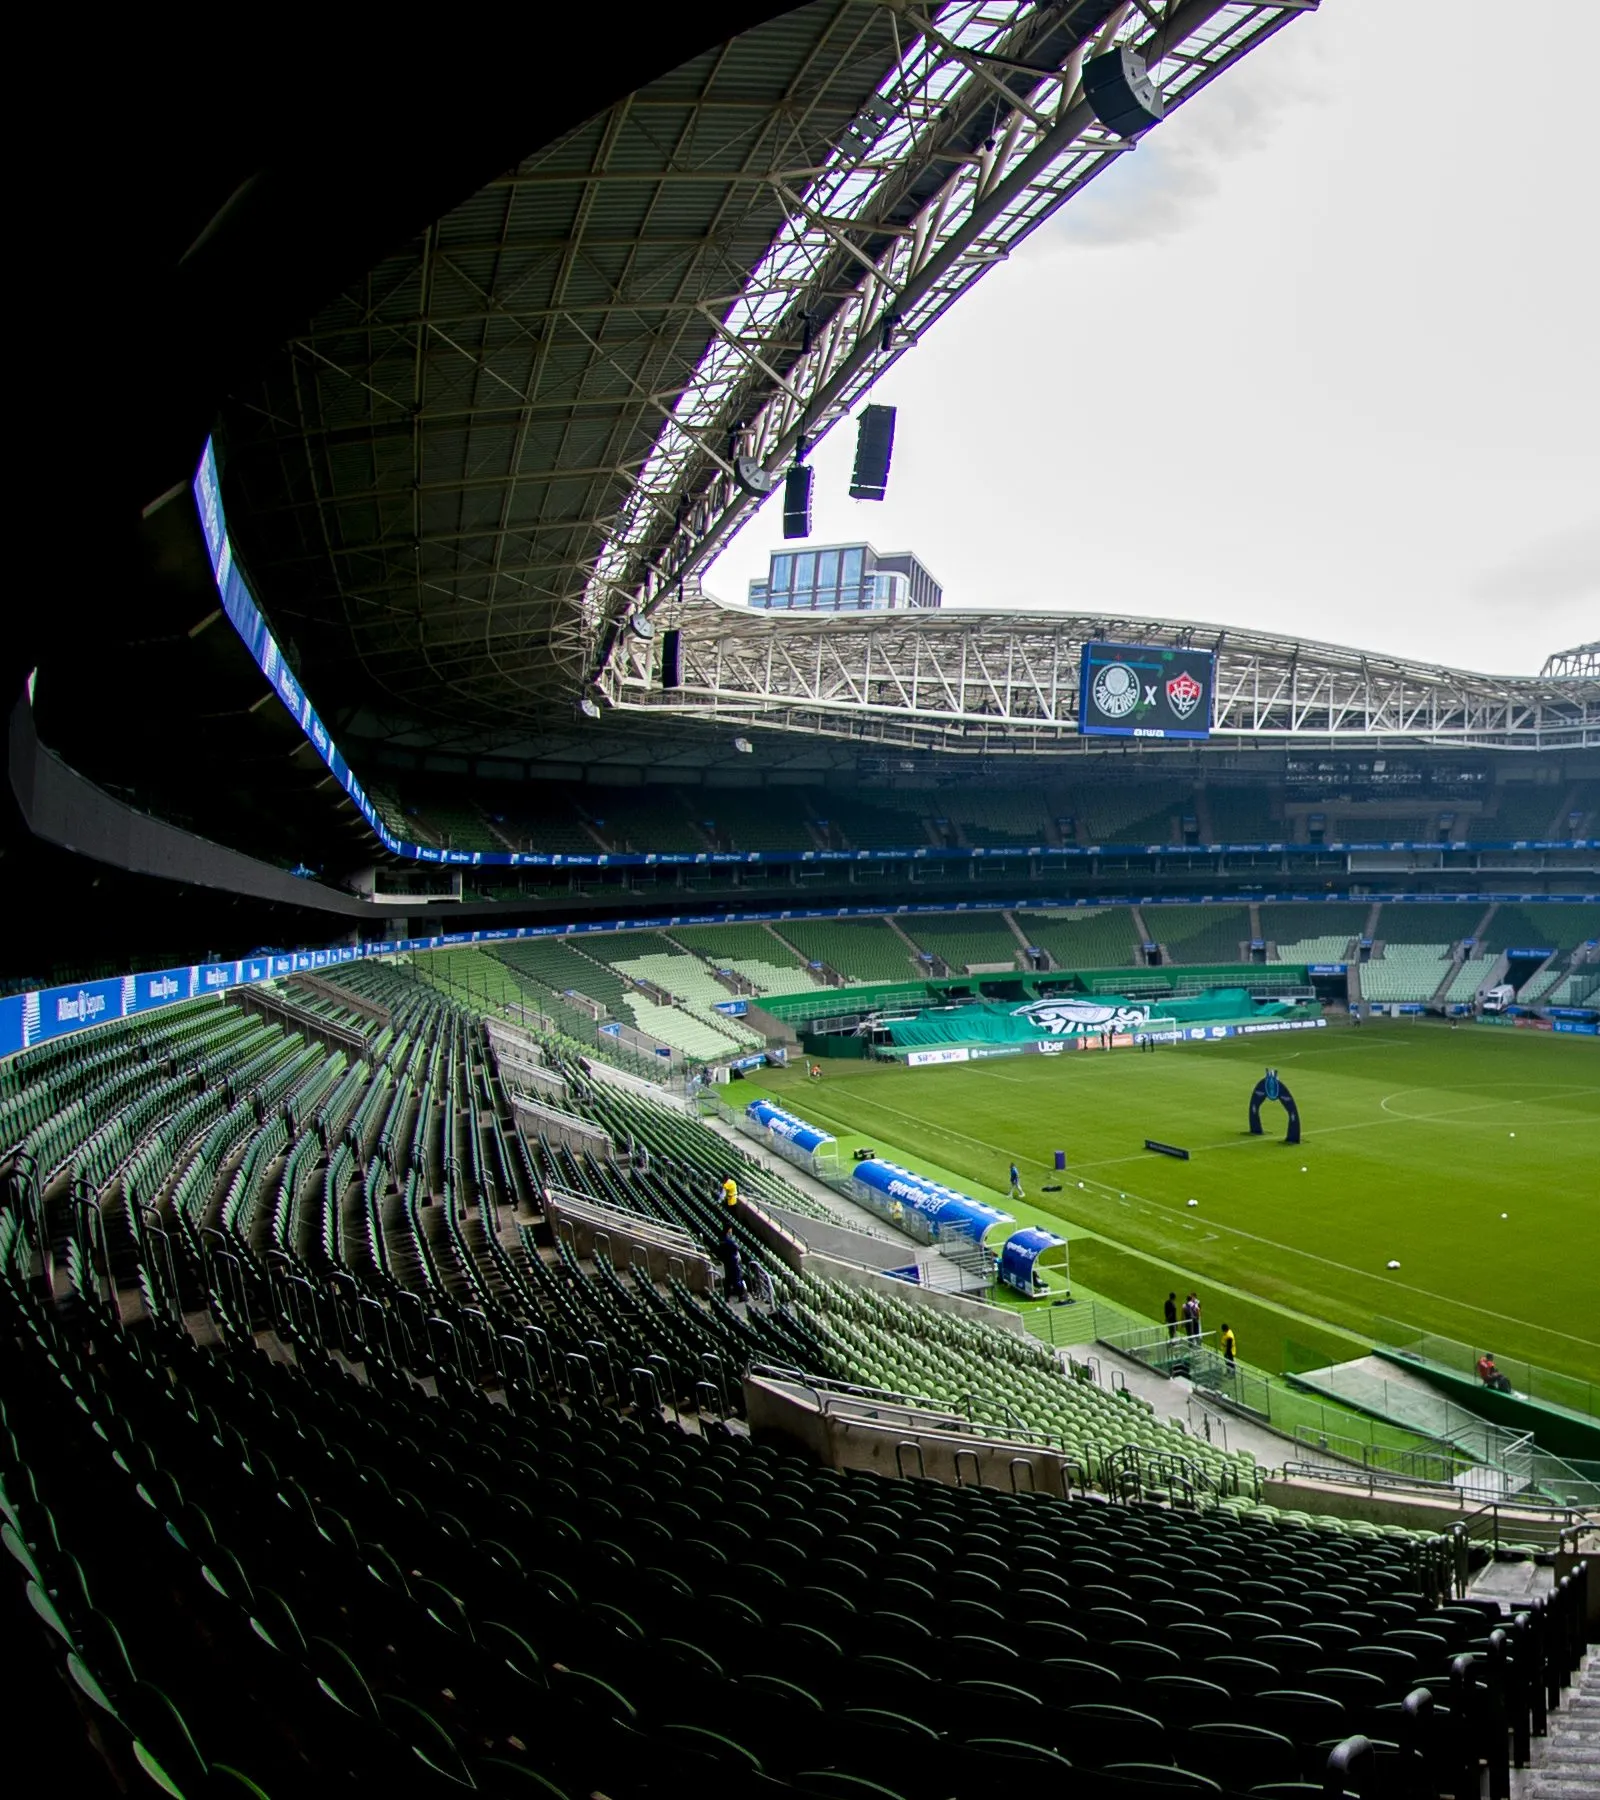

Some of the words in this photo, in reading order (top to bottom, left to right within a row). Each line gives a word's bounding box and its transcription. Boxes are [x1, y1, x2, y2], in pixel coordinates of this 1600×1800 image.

[1095, 686, 1137, 713] PALMEIRAS
[1037, 1041, 1064, 1053] Uber
[887, 1180, 951, 1214] sportingbet
